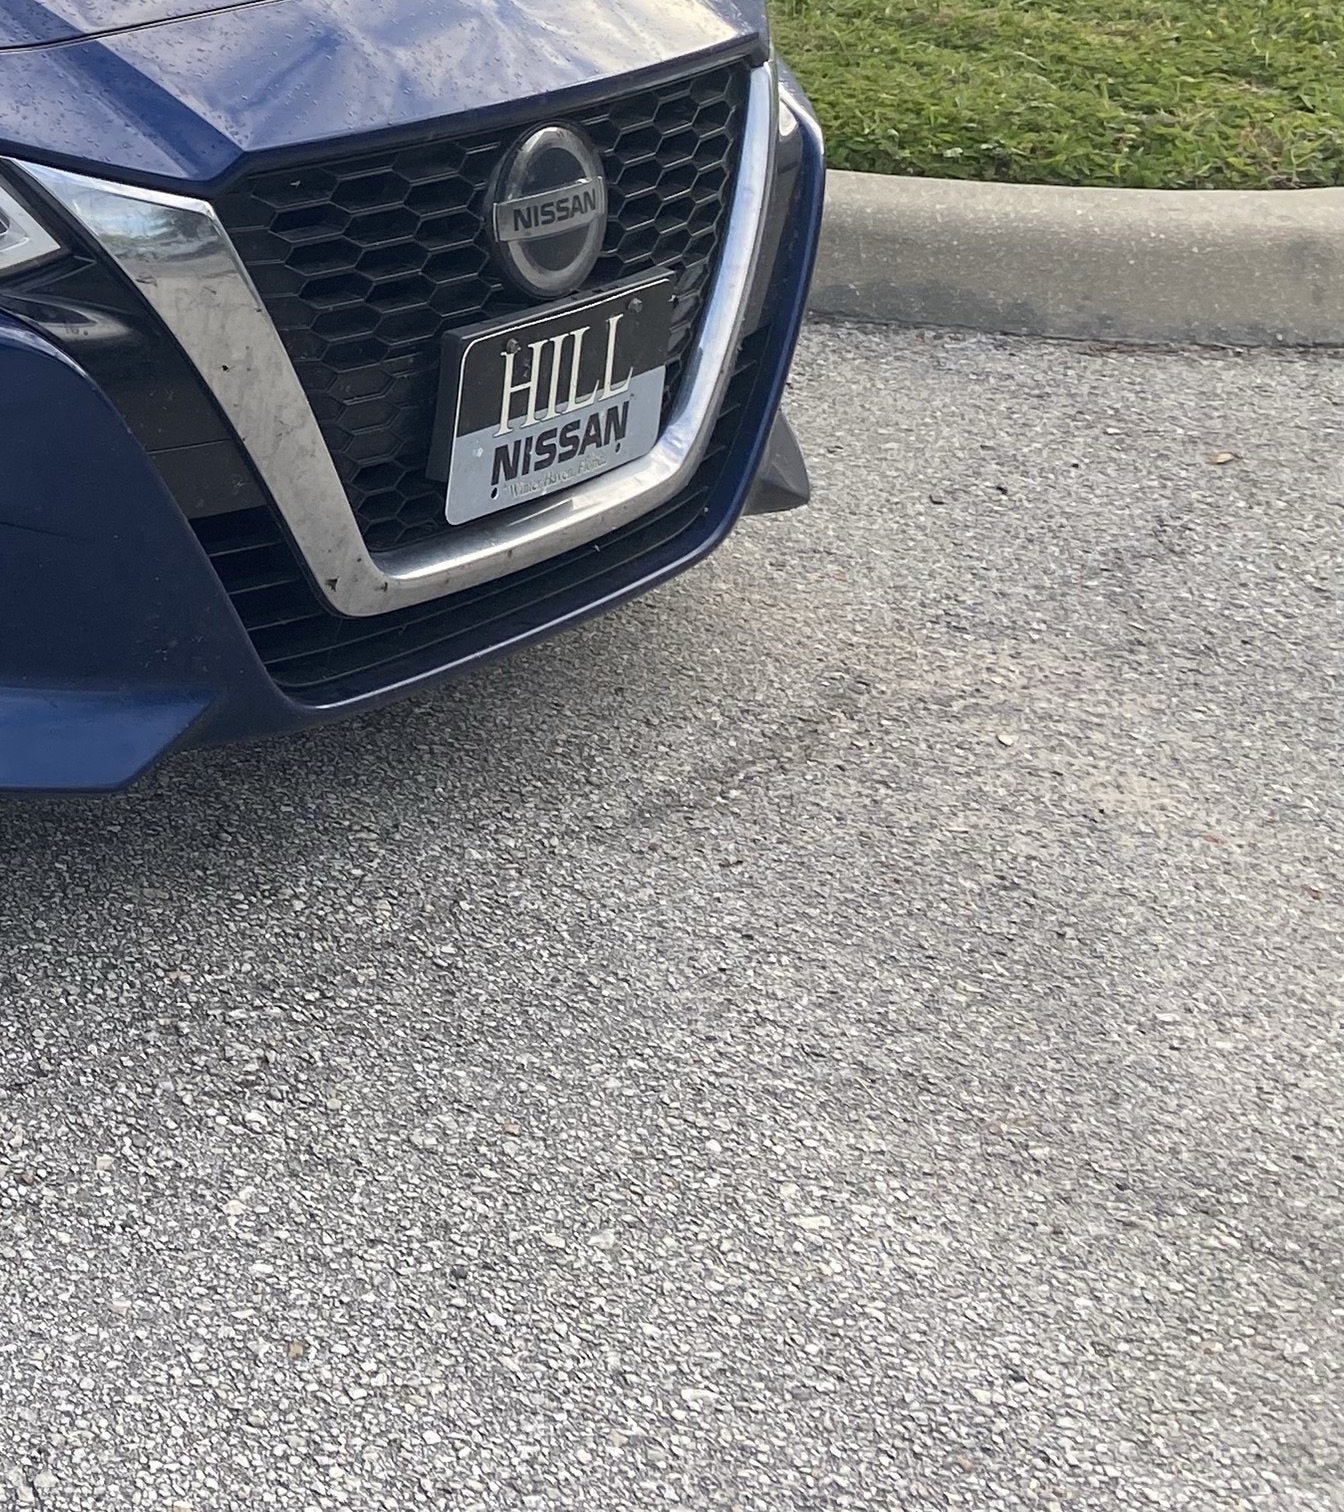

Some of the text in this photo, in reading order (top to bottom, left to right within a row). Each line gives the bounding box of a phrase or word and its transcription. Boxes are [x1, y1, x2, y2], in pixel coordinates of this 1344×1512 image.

[513, 189, 596, 231] NISSAN
[493, 314, 634, 438] HILL
[491, 401, 630, 486] NISSAN
